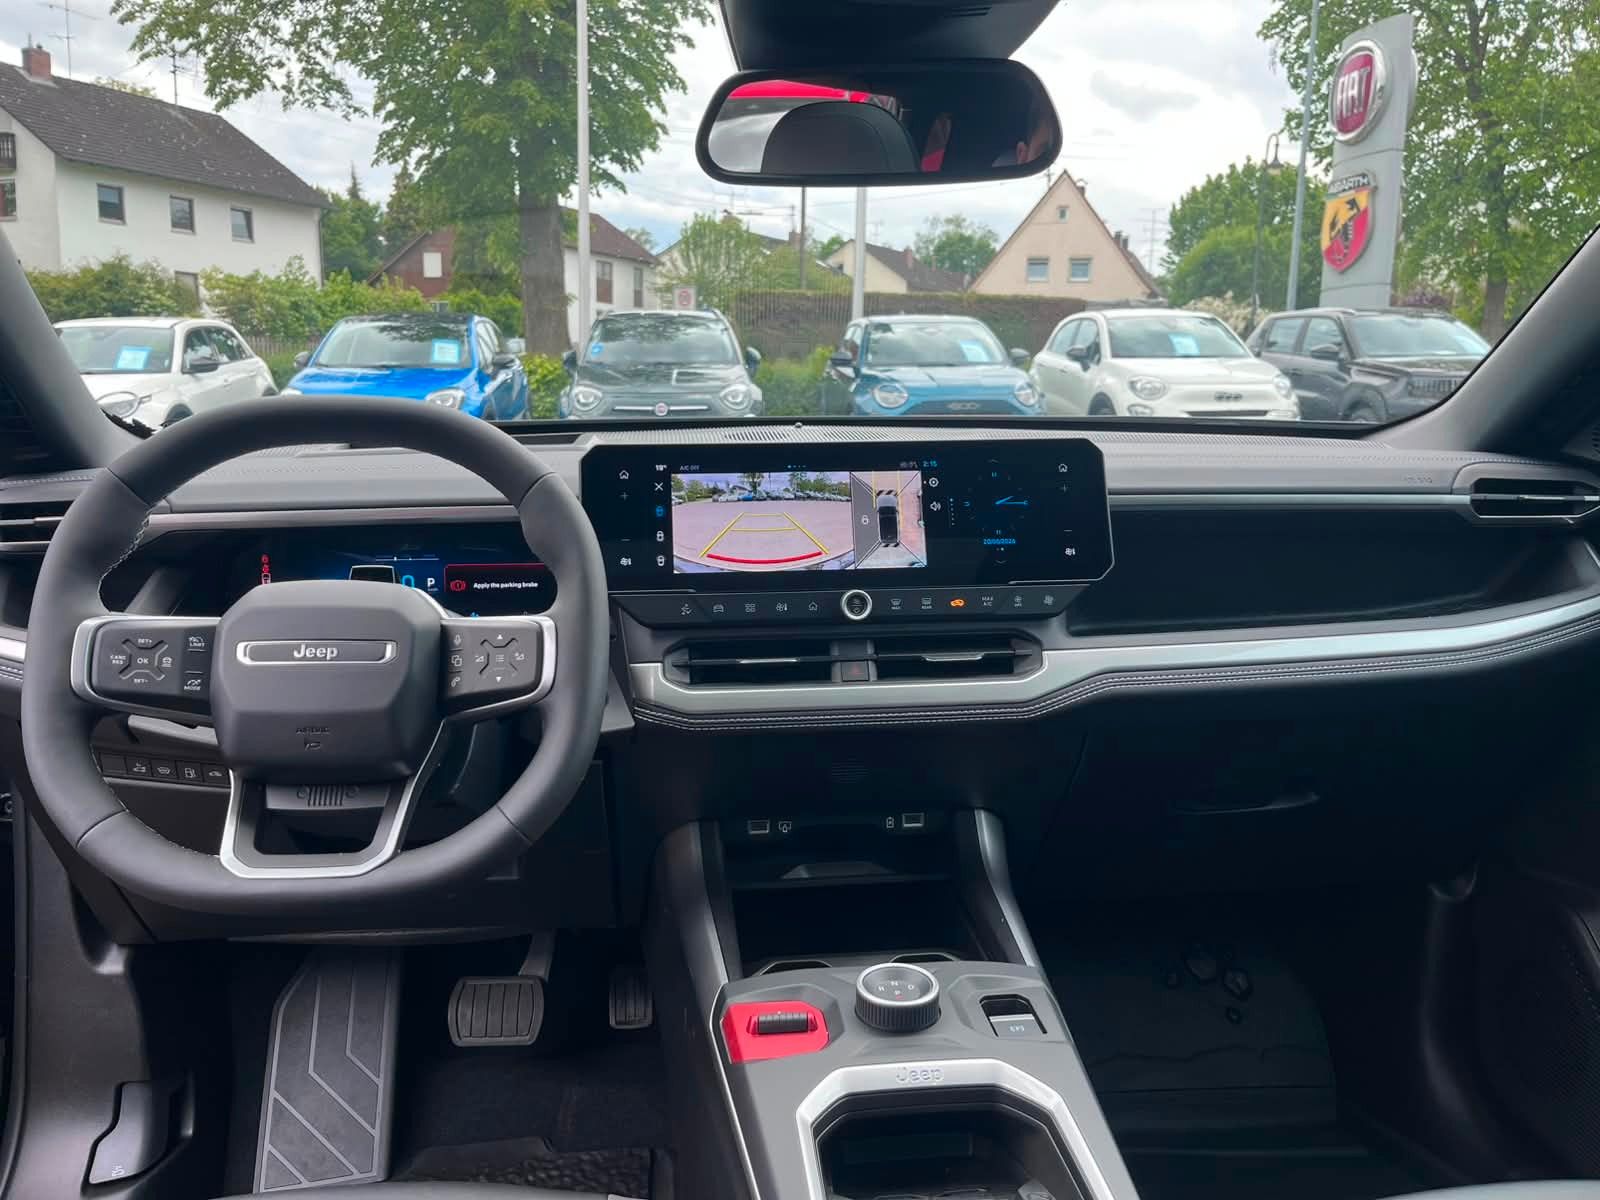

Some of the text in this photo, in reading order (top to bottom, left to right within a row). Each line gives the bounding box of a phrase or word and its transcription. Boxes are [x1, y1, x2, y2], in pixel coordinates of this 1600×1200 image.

[1336, 66, 1370, 119] FIAT
[427, 577, 436, 588] P
[473, 582, 490, 590] Apply
[293, 643, 338, 661] Jeep
[896, 1065, 943, 1086] Jeep
